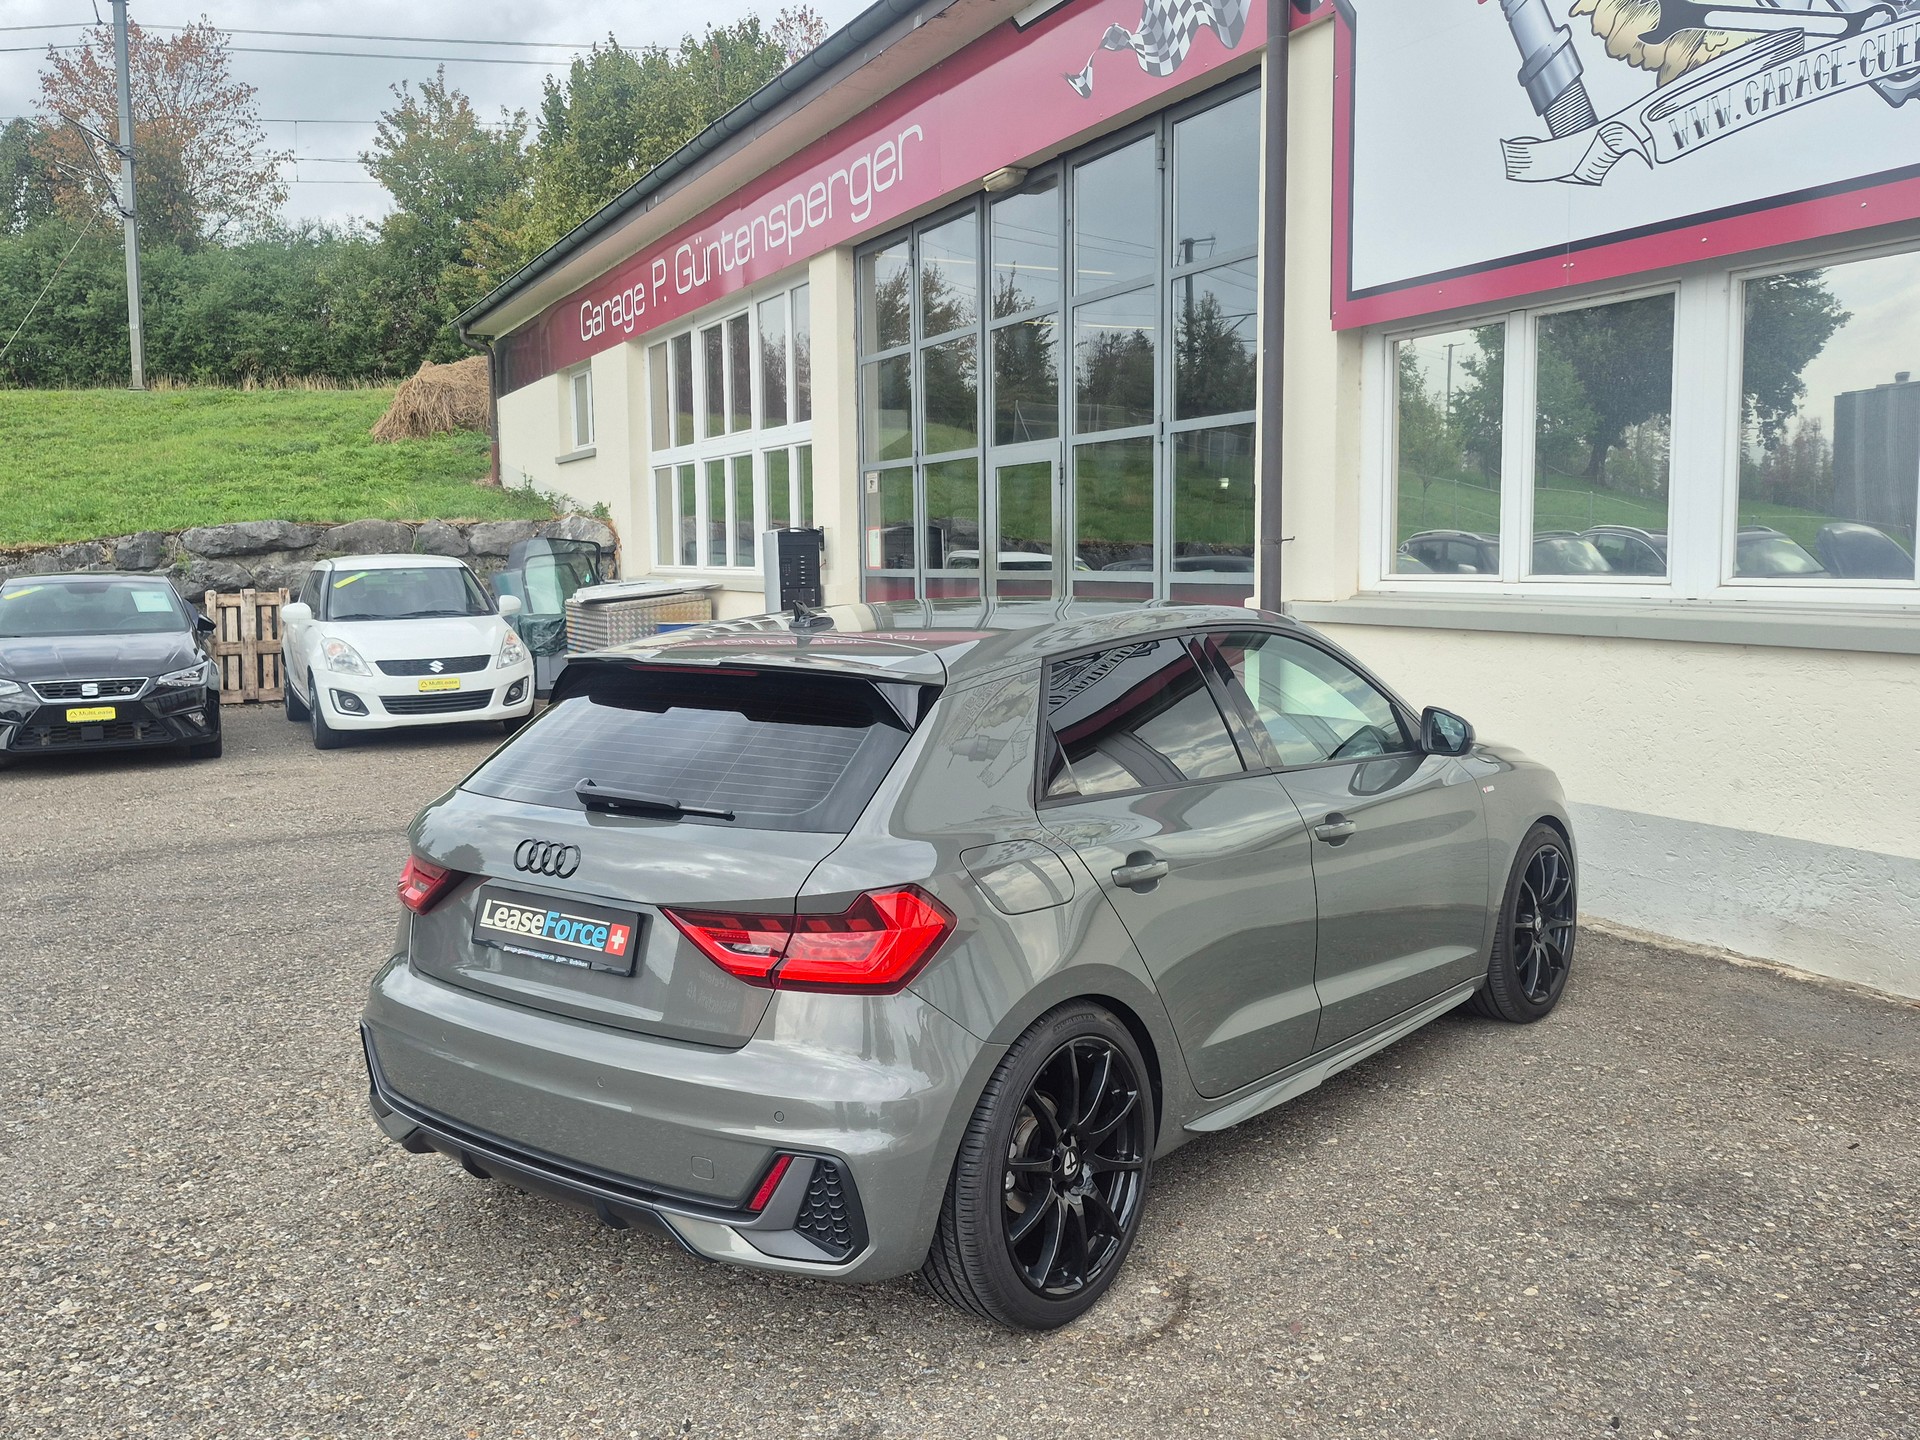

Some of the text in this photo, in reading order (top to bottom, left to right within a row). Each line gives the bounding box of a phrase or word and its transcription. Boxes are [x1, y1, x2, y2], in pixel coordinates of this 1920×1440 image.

[580, 124, 923, 342] Garage P. Güntensperger
[480, 898, 608, 948] LeaseForce
